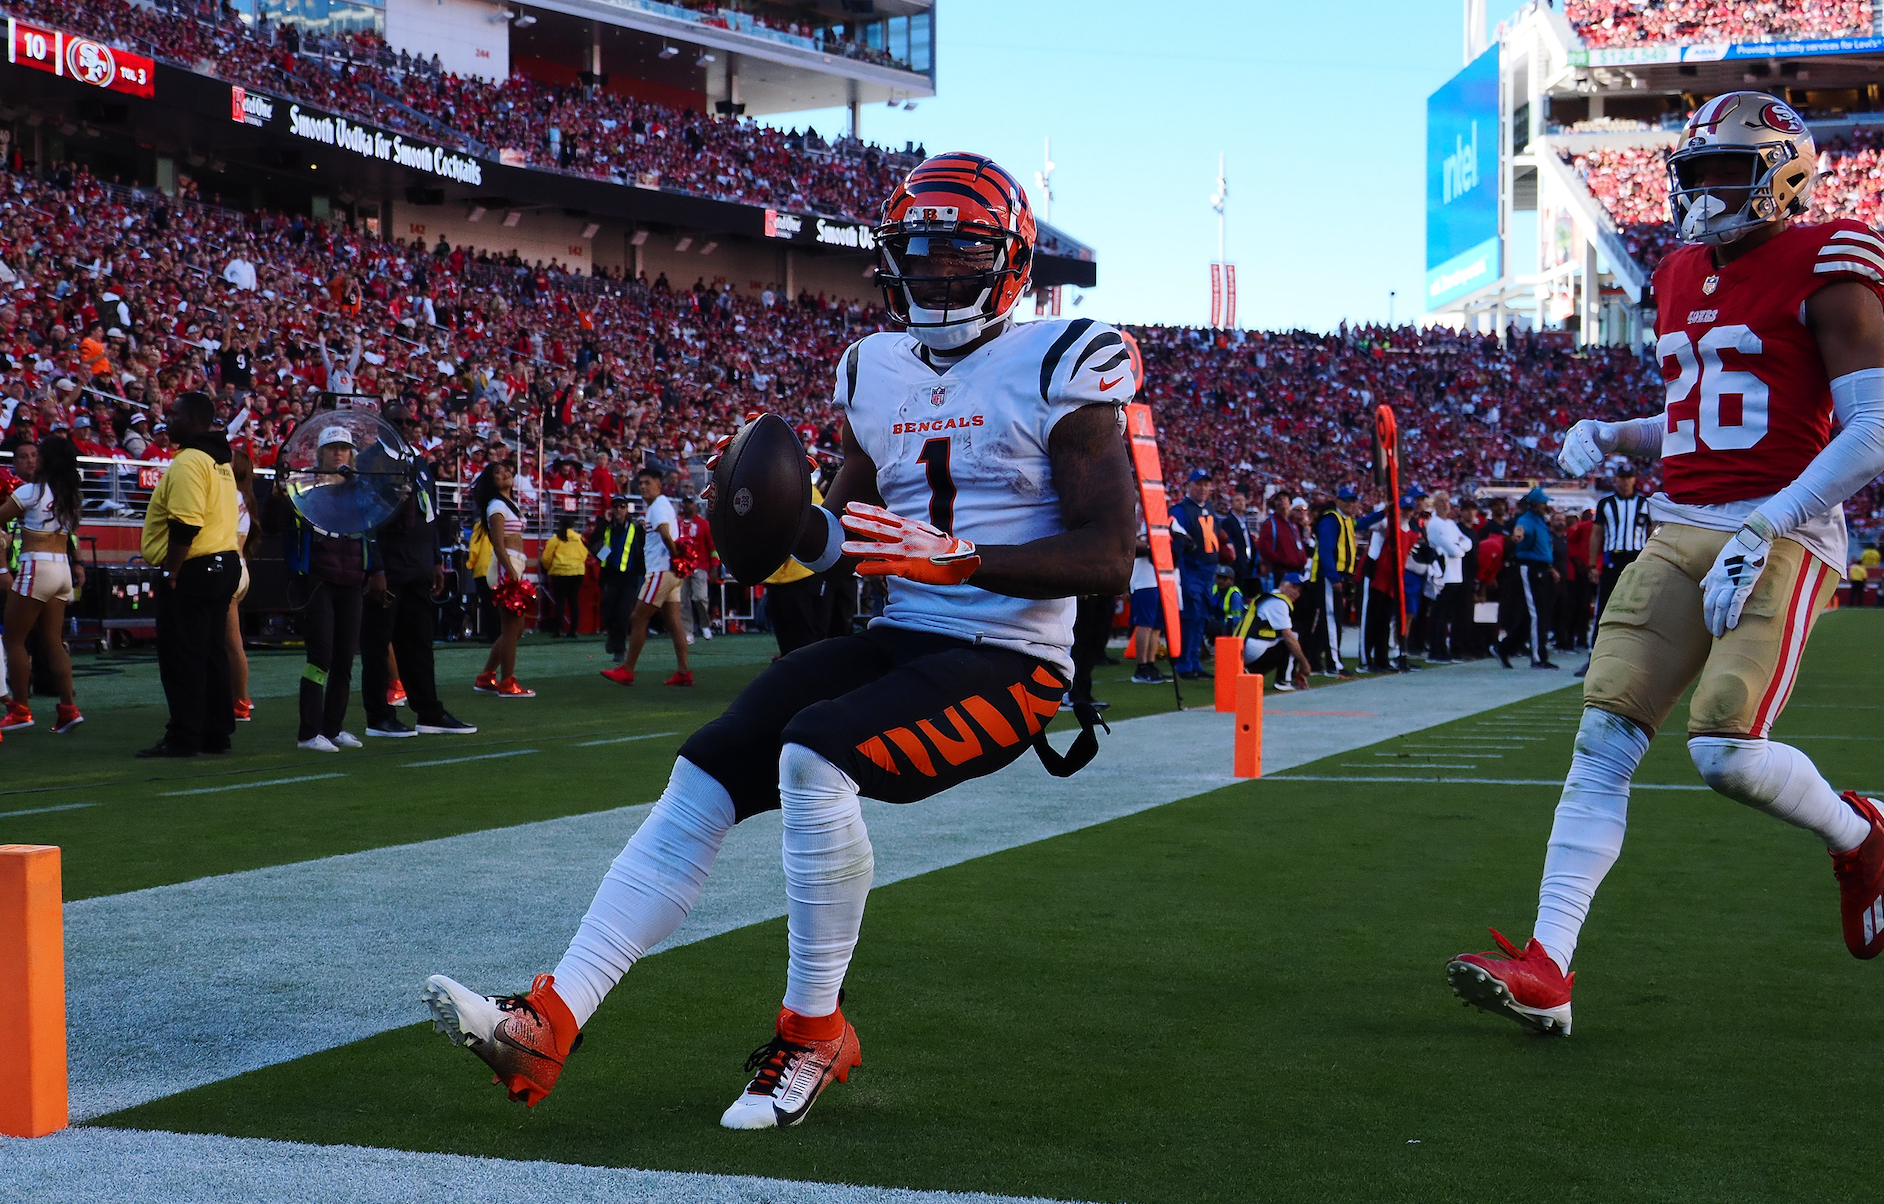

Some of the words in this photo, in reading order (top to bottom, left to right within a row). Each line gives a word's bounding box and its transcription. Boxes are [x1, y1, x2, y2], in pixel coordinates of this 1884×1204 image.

[24, 32, 47, 60] 10
[1840, 40, 1854, 50] for
[138, 68, 147, 85] 3
[290, 104, 334, 145] Smooth
[336, 117, 374, 157] Vodka
[375, 132, 392, 160] for
[393, 135, 433, 173] Smooth
[433, 146, 482, 186] Cocktails
[816, 218, 858, 248] Smooth
[1687, 309, 1719, 325] 49ERS
[236, 353, 246, 369] 9
[1656, 324, 1769, 459] 26
[892, 415, 985, 434] BENGALS
[141, 470, 160, 487] 135
[916, 436, 957, 538] 1
